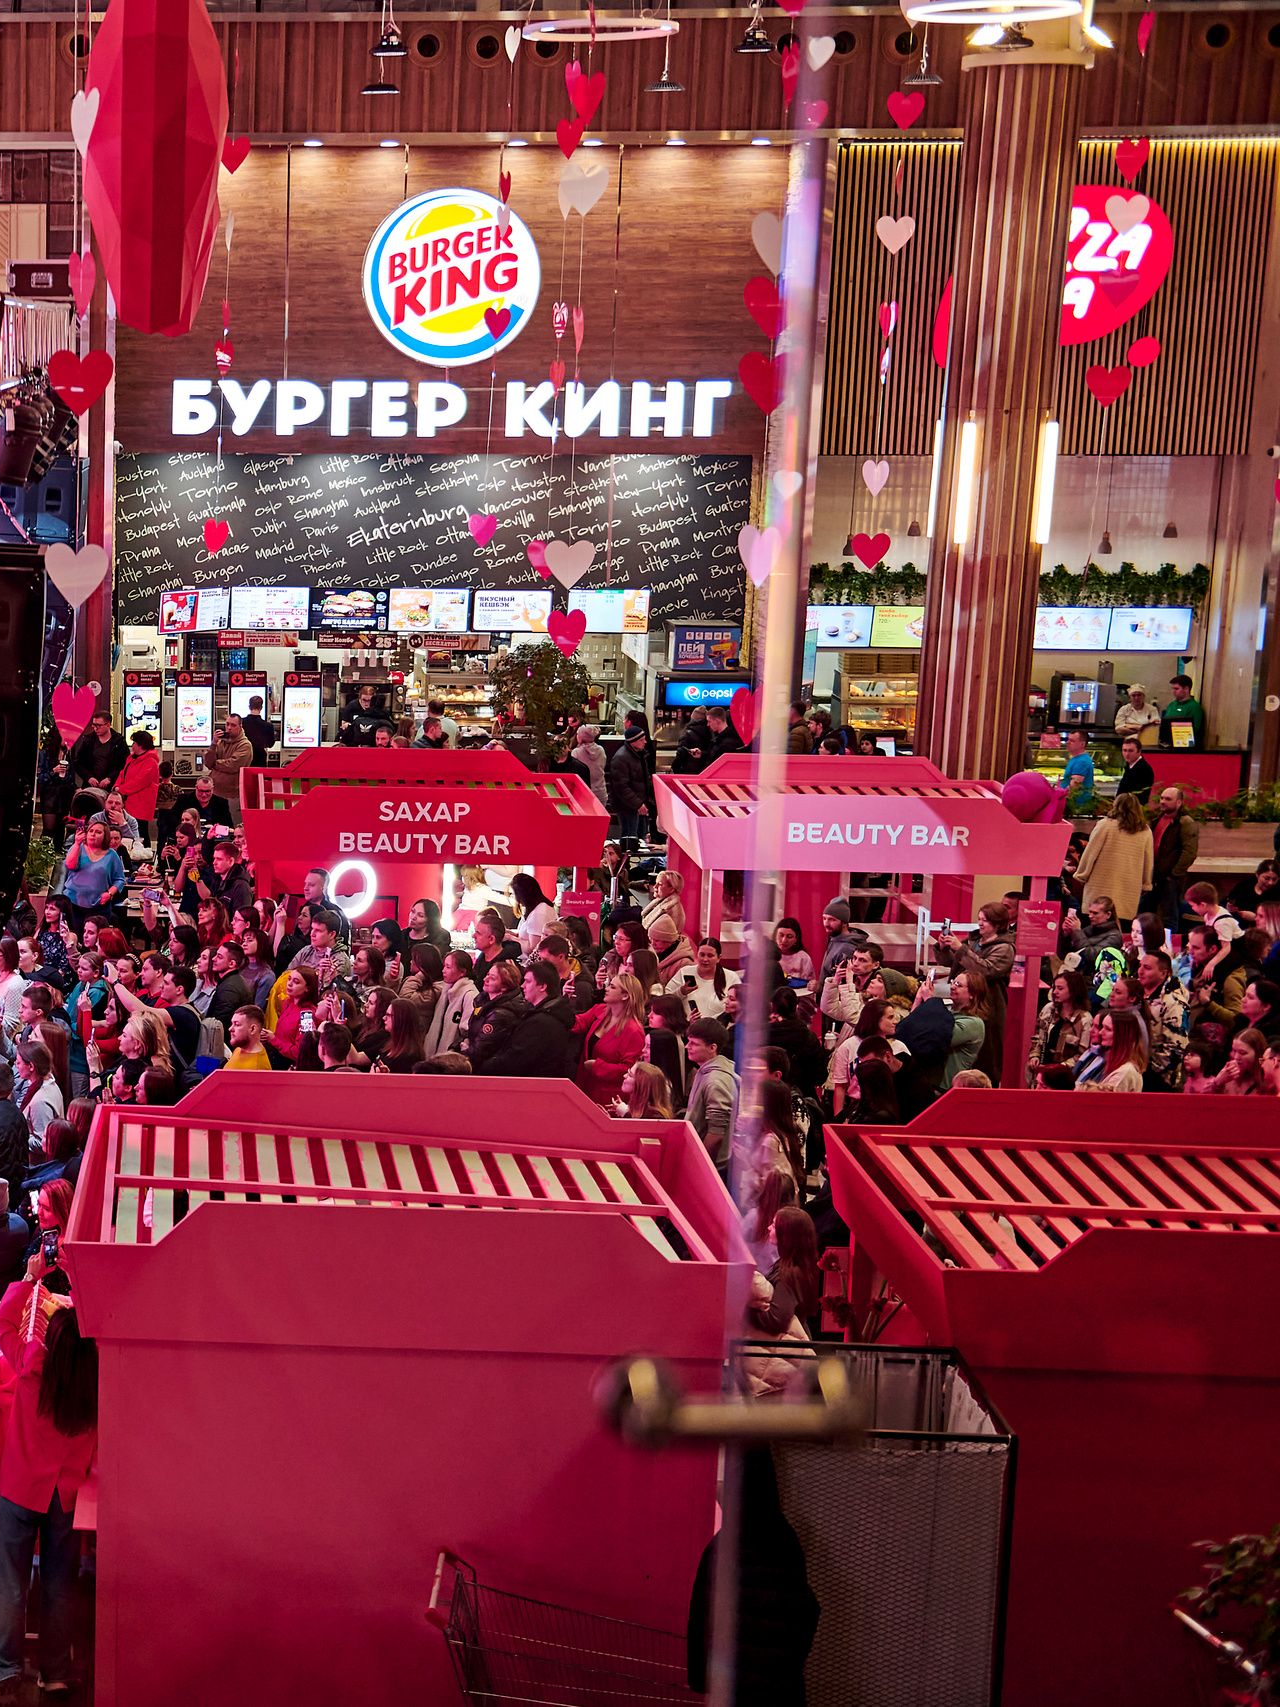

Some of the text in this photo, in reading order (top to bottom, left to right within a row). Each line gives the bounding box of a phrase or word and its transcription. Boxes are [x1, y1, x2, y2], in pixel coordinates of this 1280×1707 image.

[388, 224, 514, 285] BURGER
[393, 252, 519, 327] KING
[171, 380, 733, 439] БУРГЕР КИНГ
[179, 460, 225, 482] Auckland
[320, 456, 350, 474] Little
[429, 454, 479, 474] Segovia
[693, 460, 739, 477] Mexico
[255, 476, 310, 495] Hamburg
[328, 475, 366, 490] Mexico
[360, 473, 415, 497] Innsbruck
[415, 471, 478, 497] Stockholm
[477, 477, 506, 492] Oslo
[511, 471, 566, 491] Houston
[563, 472, 628, 497] Stockholm
[179, 481, 238, 503] Torino
[286, 489, 323, 505] Rome
[478, 489, 553, 516] Vancouver
[118, 497, 171, 523] Honolulu
[187, 496, 247, 523] Guatemala
[255, 501, 282, 516] Oslo
[293, 495, 349, 522] Shanghai
[353, 494, 400, 518] Auckland
[548, 491, 605, 519] Shanghai
[631, 492, 689, 518] Honolulu
[124, 513, 180, 542] Budapest
[251, 519, 287, 537] Dublin
[301, 522, 339, 539] Paris
[346, 504, 470, 548] Ekaterinburg
[560, 519, 621, 540] Torino
[638, 507, 697, 536] Budapest
[516, 530, 555, 545] Praha
[638, 537, 680, 555] Praha
[121, 546, 161, 564] Praha
[255, 538, 295, 559] Madrid
[284, 543, 332, 563] Norfolk
[366, 539, 428, 565] Little Rock
[473, 541, 506, 557] Oslo
[144, 559, 174, 575] Rock
[300, 557, 347, 575] Phoenix
[410, 554, 457, 574] Dundee
[485, 552, 524, 569] Rome
[638, 548, 703, 574] Little Rock
[193, 564, 243, 583] Burgen
[353, 571, 400, 588] Tokio
[421, 567, 479, 588] Domingo
[701, 688, 733, 699] pepsi
[339, 832, 510, 855] BEAUTY BAR
[787, 822, 970, 847] BEAUTY BAR
